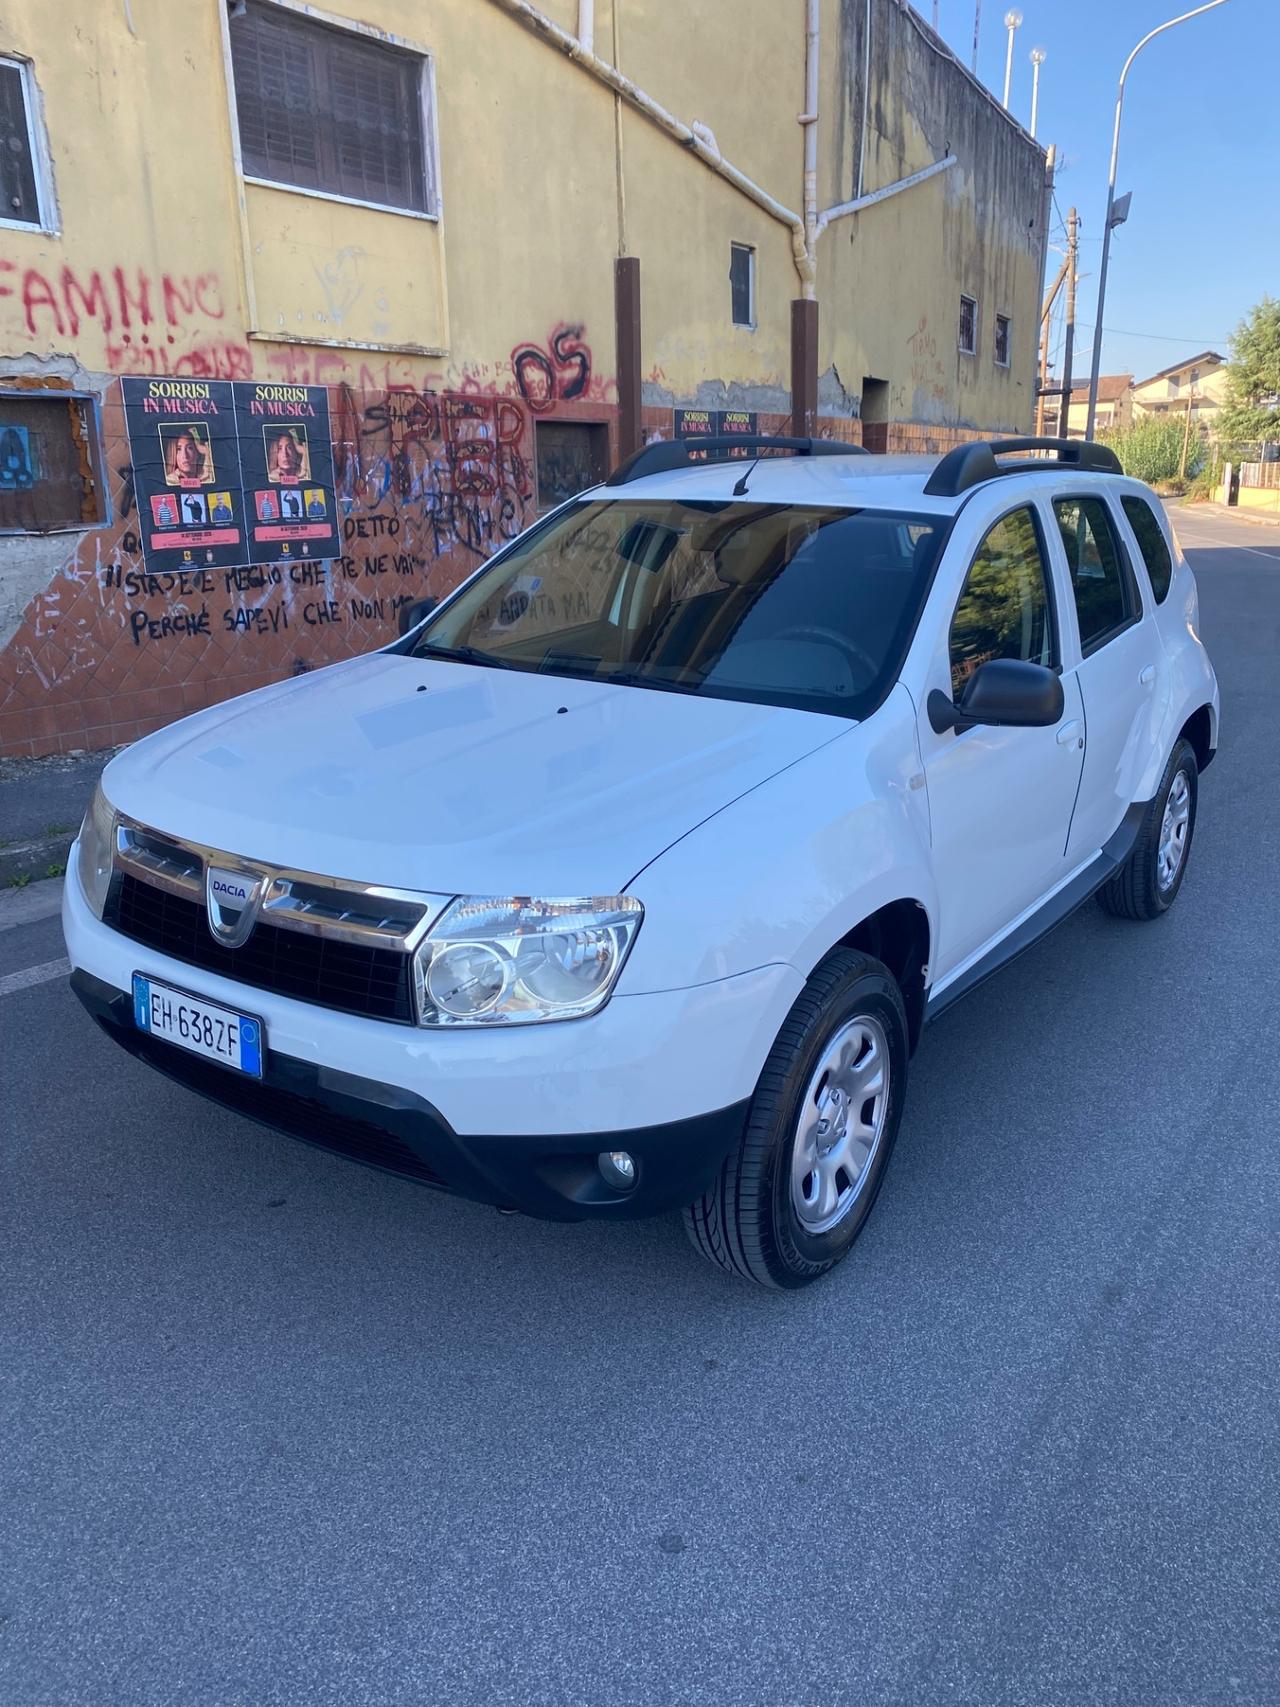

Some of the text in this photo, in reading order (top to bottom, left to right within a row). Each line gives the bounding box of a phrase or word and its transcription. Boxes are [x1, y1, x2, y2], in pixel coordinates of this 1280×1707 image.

[149, 381, 210, 399] SORRISI
[255, 385, 308, 403] SORRISI
[143, 398, 219, 415] IN MUSICA
[251, 400, 315, 417] IN MUSICA
[344, 513, 400, 539] DETTO
[290, 560, 327, 586] CHE
[334, 556, 358, 580] TE
[365, 553, 387, 577] NE
[303, 602, 342, 625] CHE
[352, 598, 384, 620] NON
[212, 880, 246, 899] DACIA
[151, 994, 172, 1030] EH
[178, 1004, 238, 1057] 638ZF
